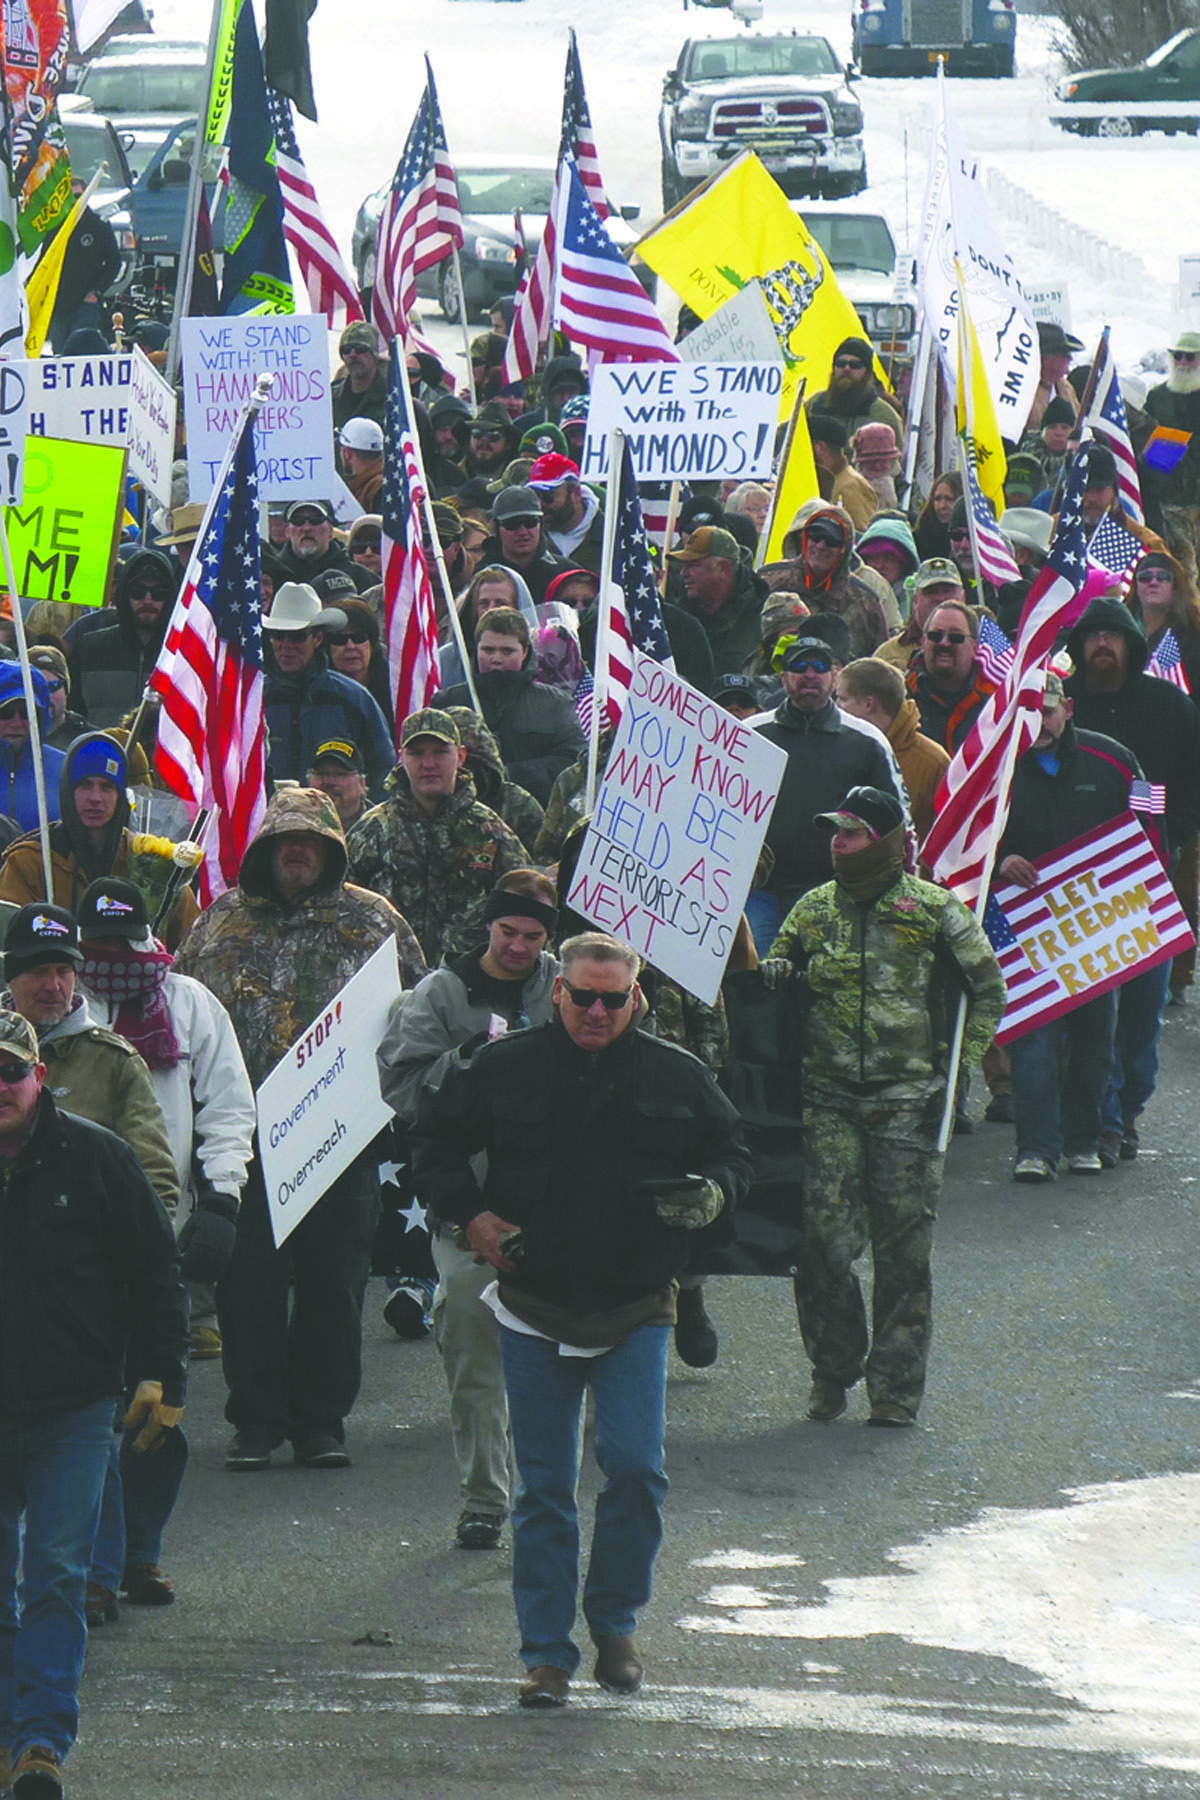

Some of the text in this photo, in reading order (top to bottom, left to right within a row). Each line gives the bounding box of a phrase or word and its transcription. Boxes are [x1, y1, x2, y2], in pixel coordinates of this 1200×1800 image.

[200, 325, 312, 348] WE STAND
[259, 349, 303, 368] THE
[687, 311, 741, 360] Probable
[609, 369, 678, 395] WE
[689, 365, 782, 396] STAND
[693, 399, 738, 421] The
[80, 407, 128, 436] THE
[632, 658, 751, 763] SOMEONE
[627, 697, 776, 823] YOU KNOW
[605, 748, 742, 863] MAY BE
[596, 787, 732, 912] HELD AS
[590, 828, 733, 957] TERRORISTS
[1020, 883, 1153, 973] FREEDOM
[1044, 870, 1099, 920] LET
[1056, 920, 1162, 996] REIGN
[296, 1000, 343, 1070] STOP!
[269, 1046, 347, 1150] Government
[278, 1119, 347, 1206] Overreach
